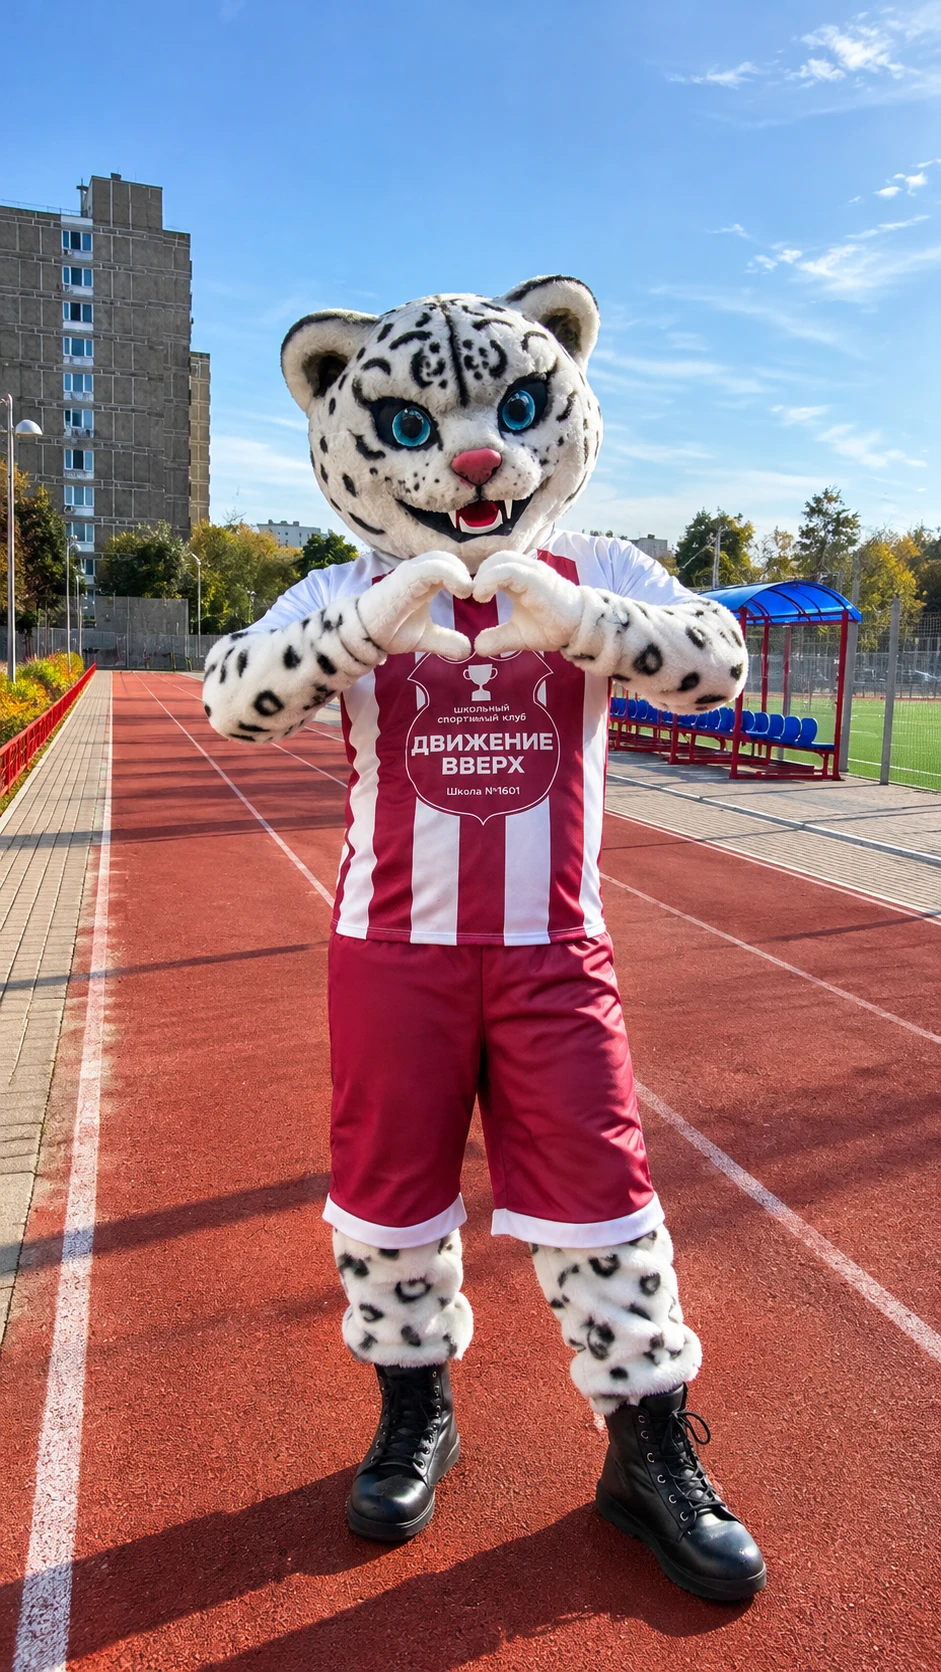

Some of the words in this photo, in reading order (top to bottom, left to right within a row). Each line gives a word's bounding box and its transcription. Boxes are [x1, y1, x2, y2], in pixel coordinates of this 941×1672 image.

[453, 704, 510, 714] школьный
[502, 713, 527, 723] клуб
[411, 733, 553, 756] ДВИЖЕНИЕ
[441, 756, 525, 775] ВВЕРХ
[446, 787, 482, 796] Школа
